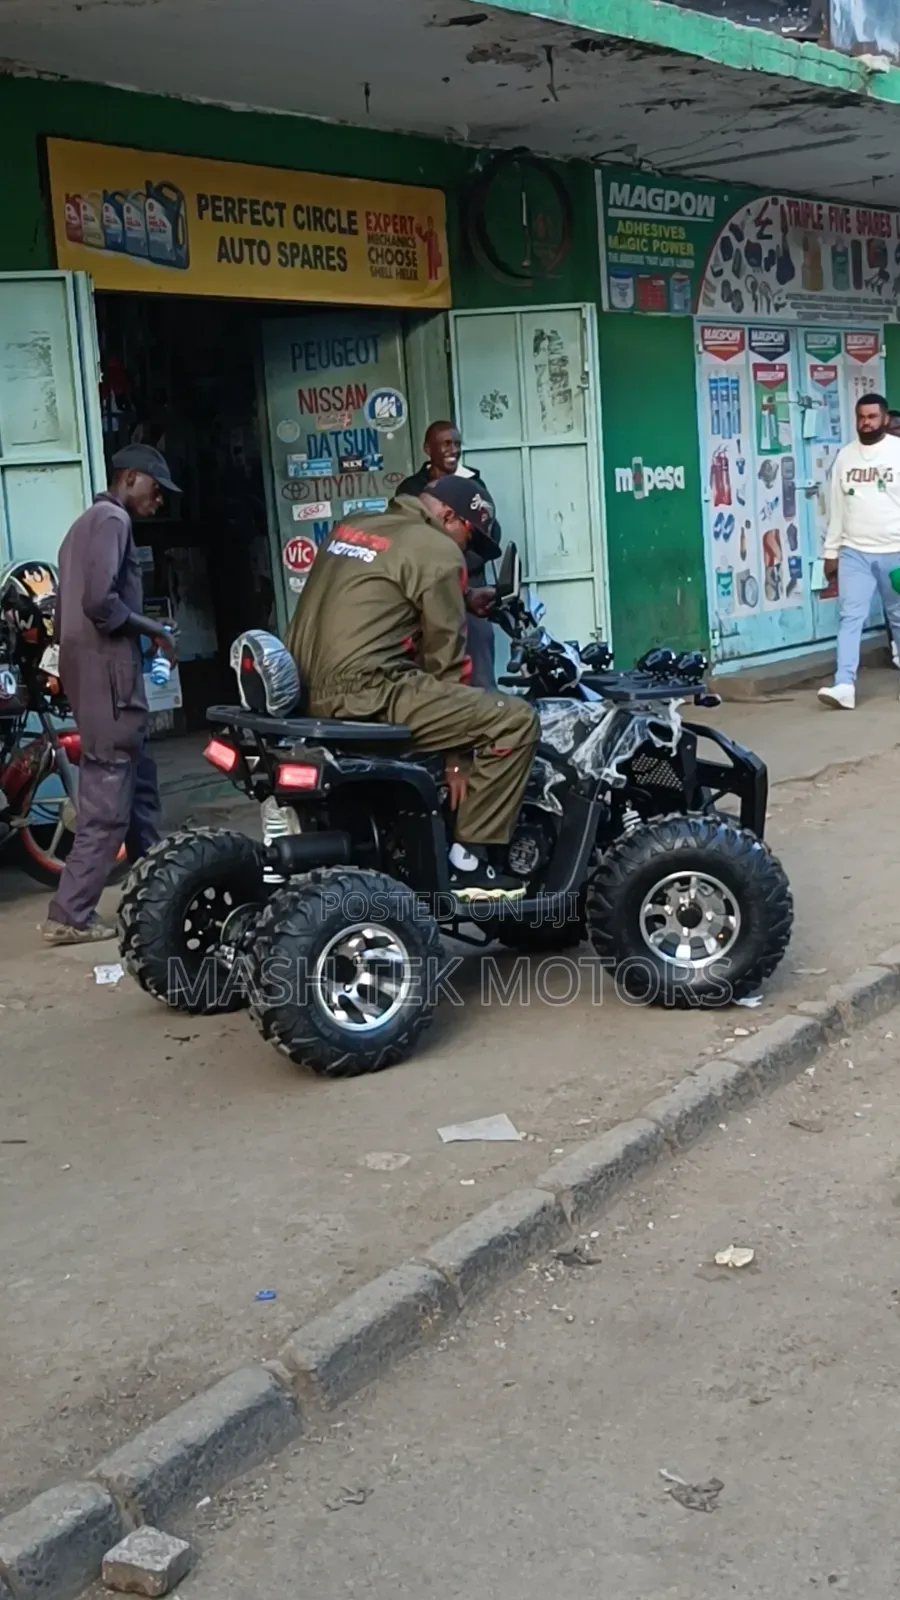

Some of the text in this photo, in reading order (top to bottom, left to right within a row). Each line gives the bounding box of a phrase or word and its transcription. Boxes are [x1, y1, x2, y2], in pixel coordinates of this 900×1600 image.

[196, 192, 287, 228] PERFECT
[292, 203, 359, 236] CIRCLE
[609, 182, 716, 217] MAGPOW
[365, 210, 416, 236] EXPERT
[616, 220, 686, 239] ADHESIVES
[787, 200, 824, 230] TRIPLE
[828, 205, 852, 235] FIVE
[856, 210, 892, 238] SPARES
[217, 235, 348, 273] AUTO SPARES
[367, 232, 417, 249] MECHANICS
[608, 235, 695, 256] MAGIC POWER
[368, 246, 418, 268] CHOOSE
[290, 334, 381, 372] PEUGEOT
[297, 383, 368, 415] NISSAN
[306, 427, 379, 460] DATSUN
[313, 473, 381, 502] TOYOTA
[846, 466, 893, 484] YOUNG
[326, 539, 378, 563] MOTORS
